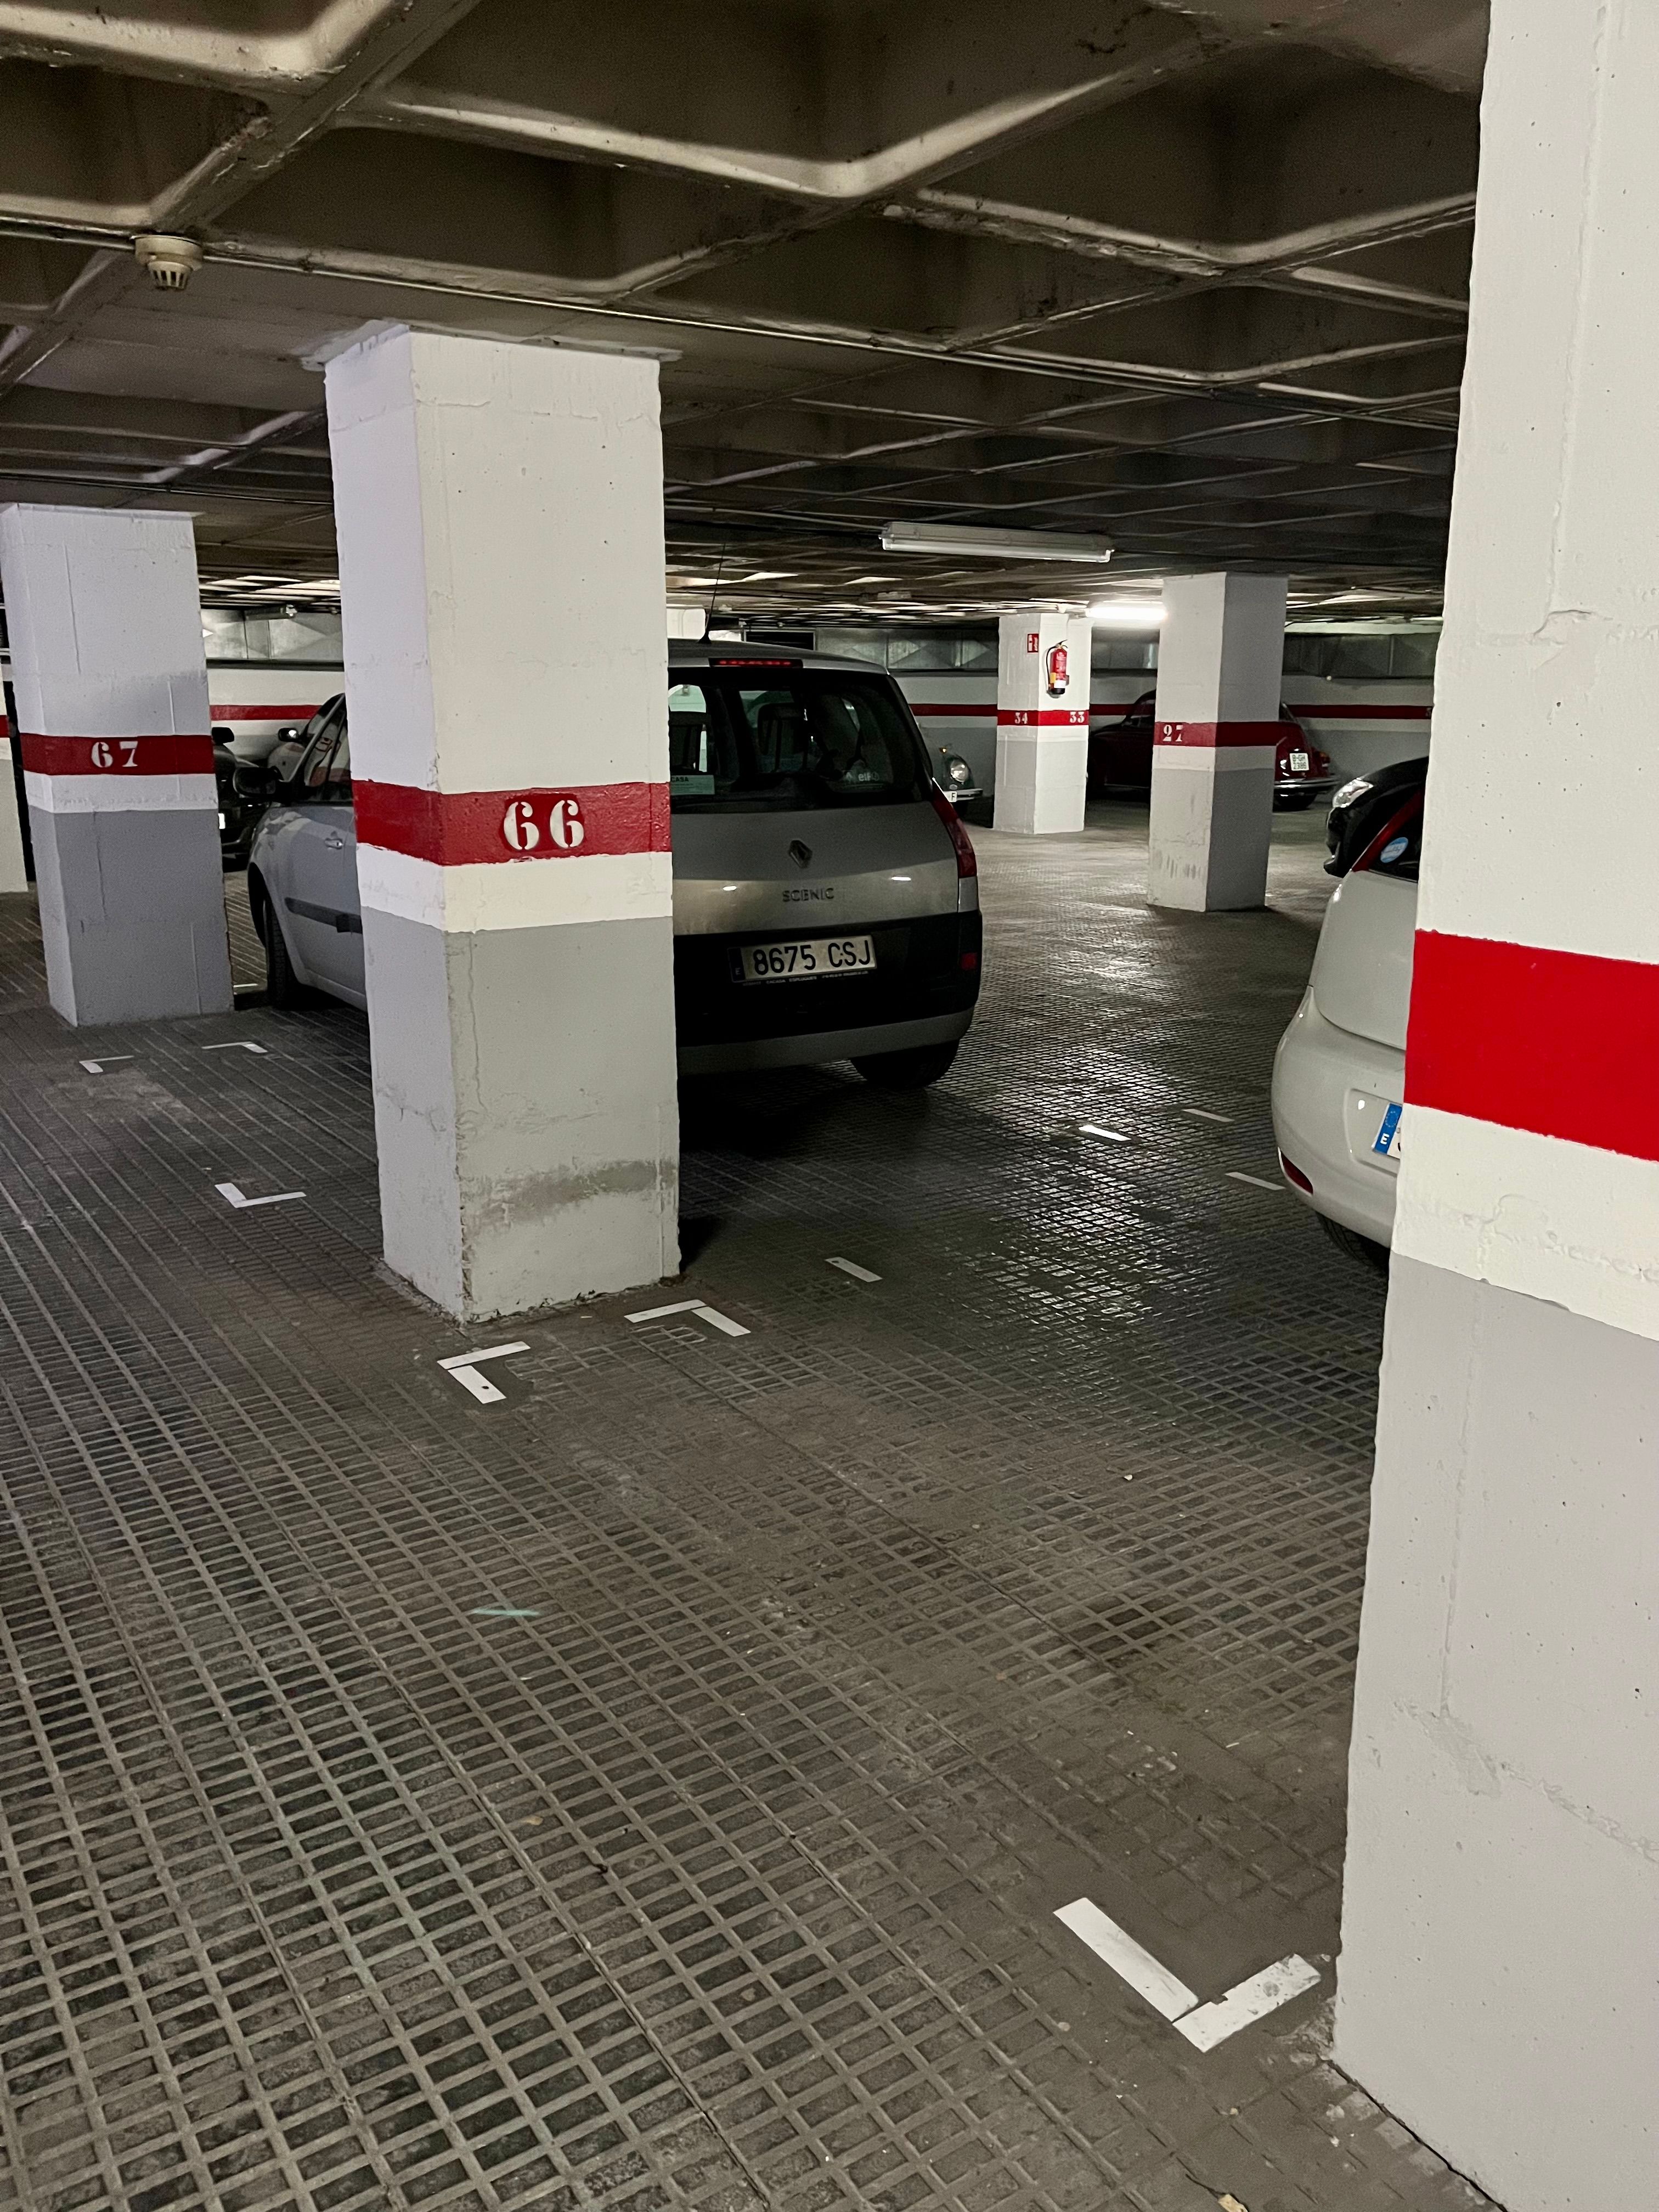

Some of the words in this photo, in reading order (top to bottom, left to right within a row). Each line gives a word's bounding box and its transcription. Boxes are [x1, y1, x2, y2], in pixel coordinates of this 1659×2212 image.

[1015, 712, 1028, 724] 34
[1070, 712, 1085, 723] 33
[1163, 725, 1184, 742] 27
[91, 741, 138, 768] 67
[504, 800, 584, 850] 66
[782, 888, 834, 902] SCENIC
[752, 944, 816, 975] 8675
[827, 940, 871, 968] CSJ
[1380, 1133, 1390, 1145] E
